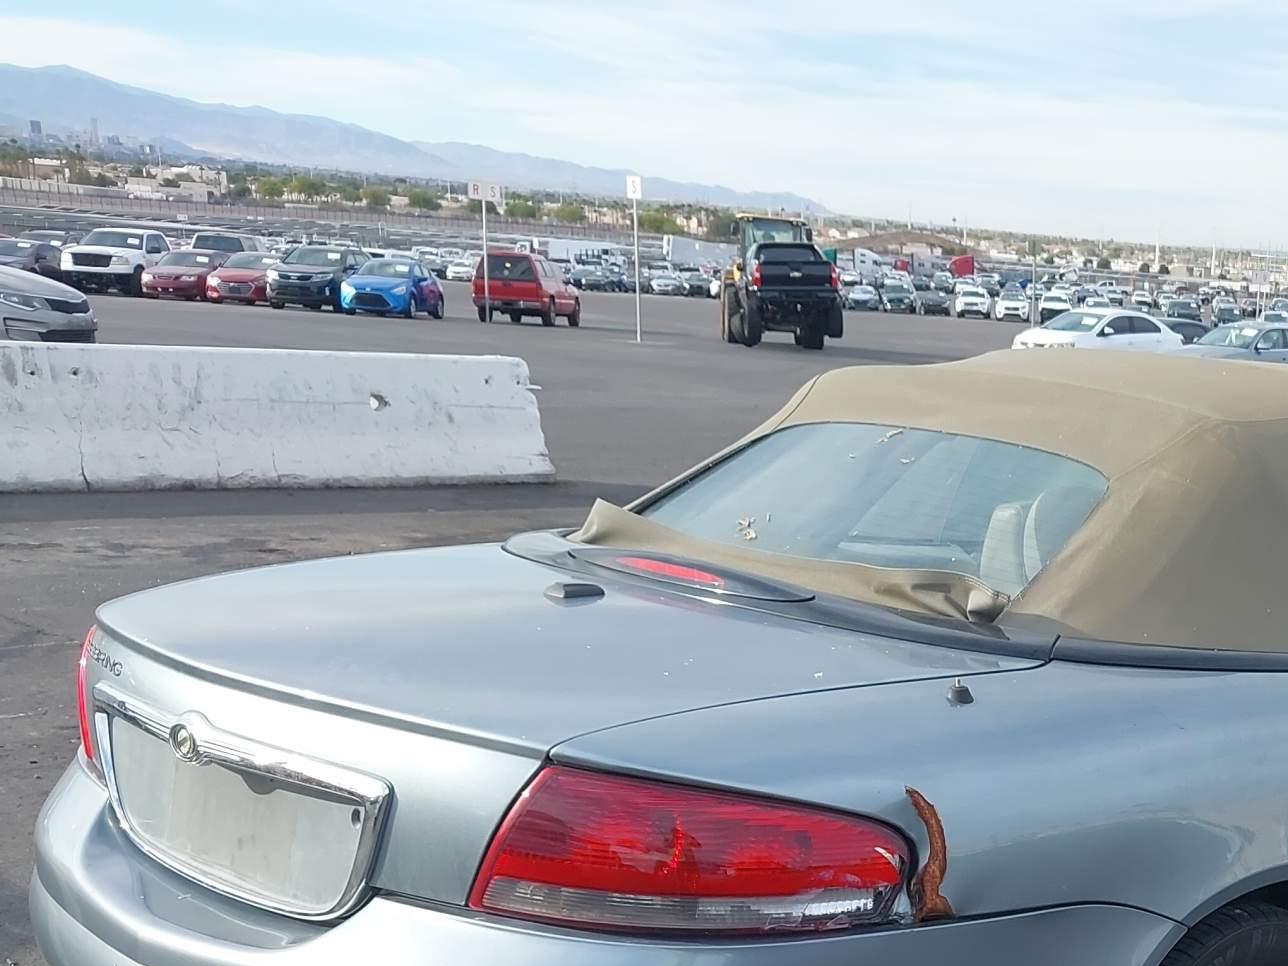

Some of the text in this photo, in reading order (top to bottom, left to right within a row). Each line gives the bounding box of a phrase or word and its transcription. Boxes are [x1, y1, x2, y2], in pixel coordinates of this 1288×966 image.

[473, 184, 497, 199] R S
[631, 180, 638, 194] S
